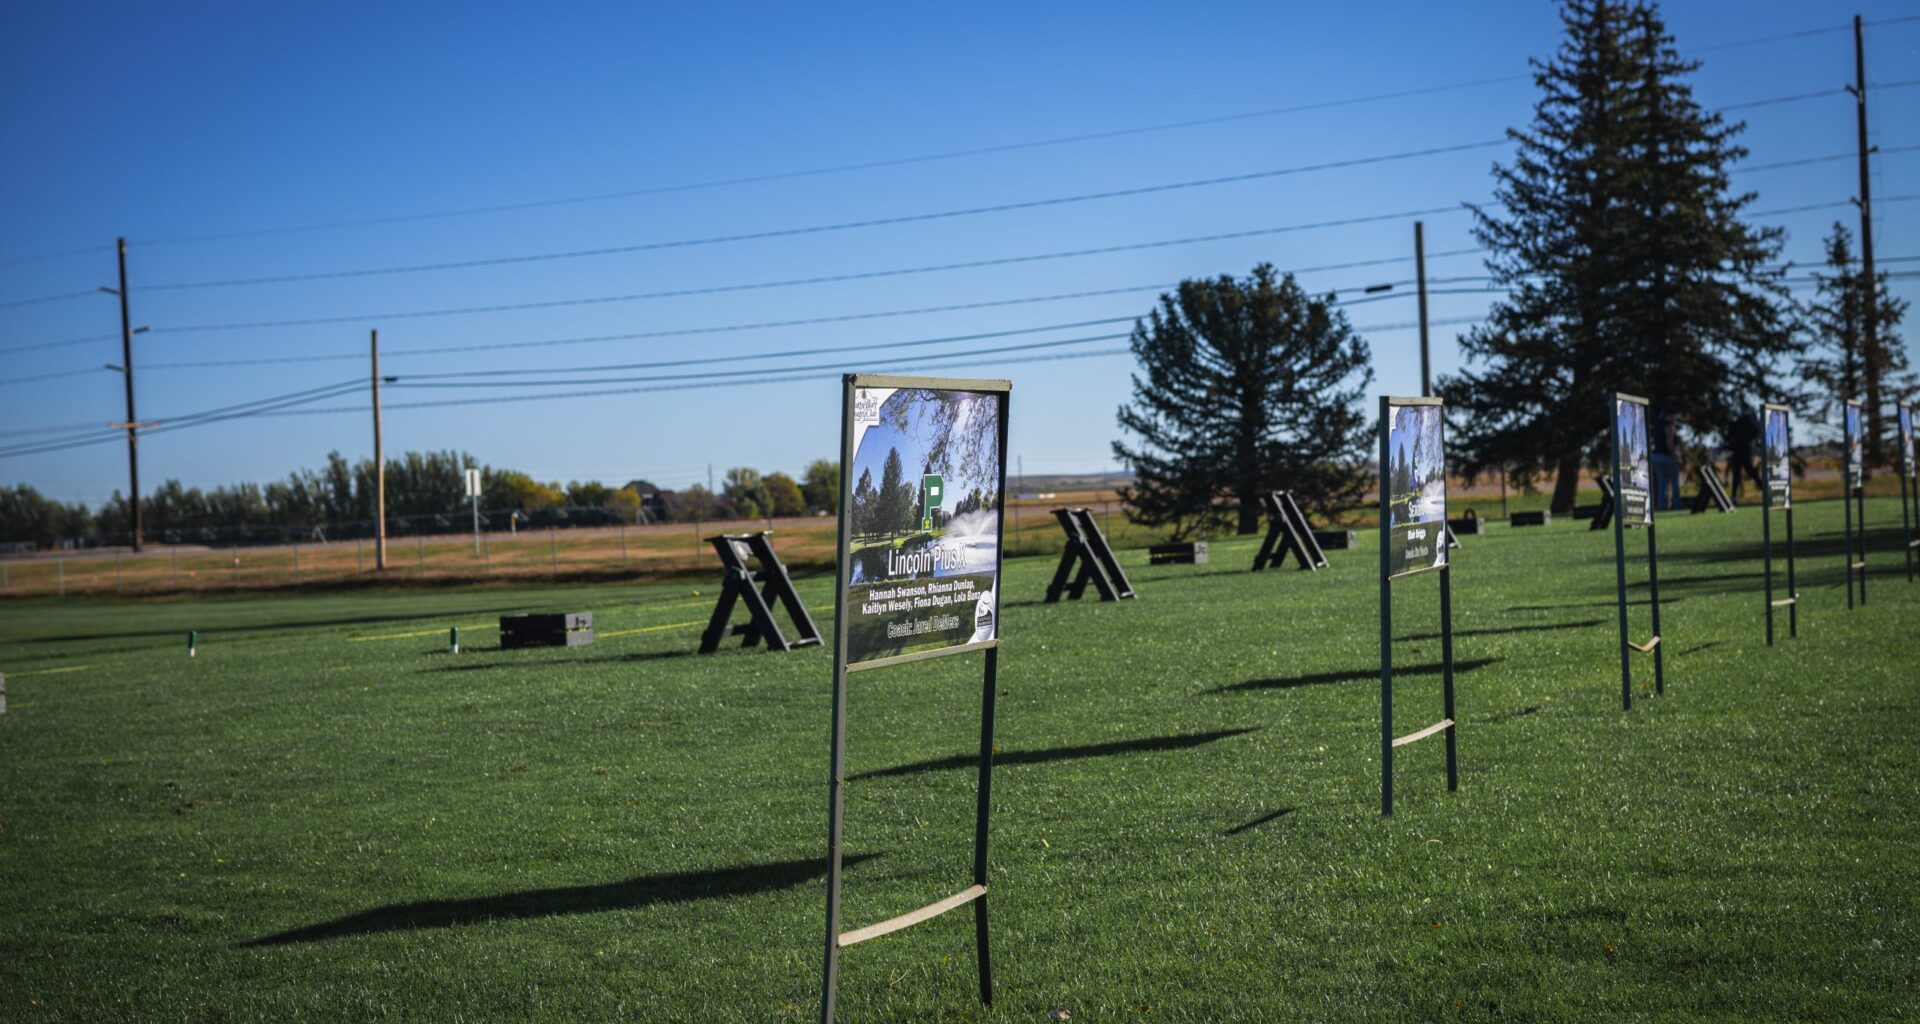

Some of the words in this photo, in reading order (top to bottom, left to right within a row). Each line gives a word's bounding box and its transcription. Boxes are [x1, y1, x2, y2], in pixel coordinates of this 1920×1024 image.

[922, 474, 944, 532] P
[888, 549, 931, 575] Lincoln
[934, 545, 956, 570] Pius
[958, 542, 966, 568] X
[870, 589, 895, 600] Hannah
[897, 586, 927, 598] Swanson,
[928, 583, 952, 593] Rhianna
[954, 580, 975, 590] Dunlap,
[862, 604, 887, 615] Kaitlyn
[888, 600, 913, 611] Wesely,
[914, 598, 931, 608] Fiona
[932, 595, 952, 607] Dugan,
[954, 593, 966, 602] Lola
[888, 619, 912, 638] Coach:
[913, 616, 932, 635] Jared
